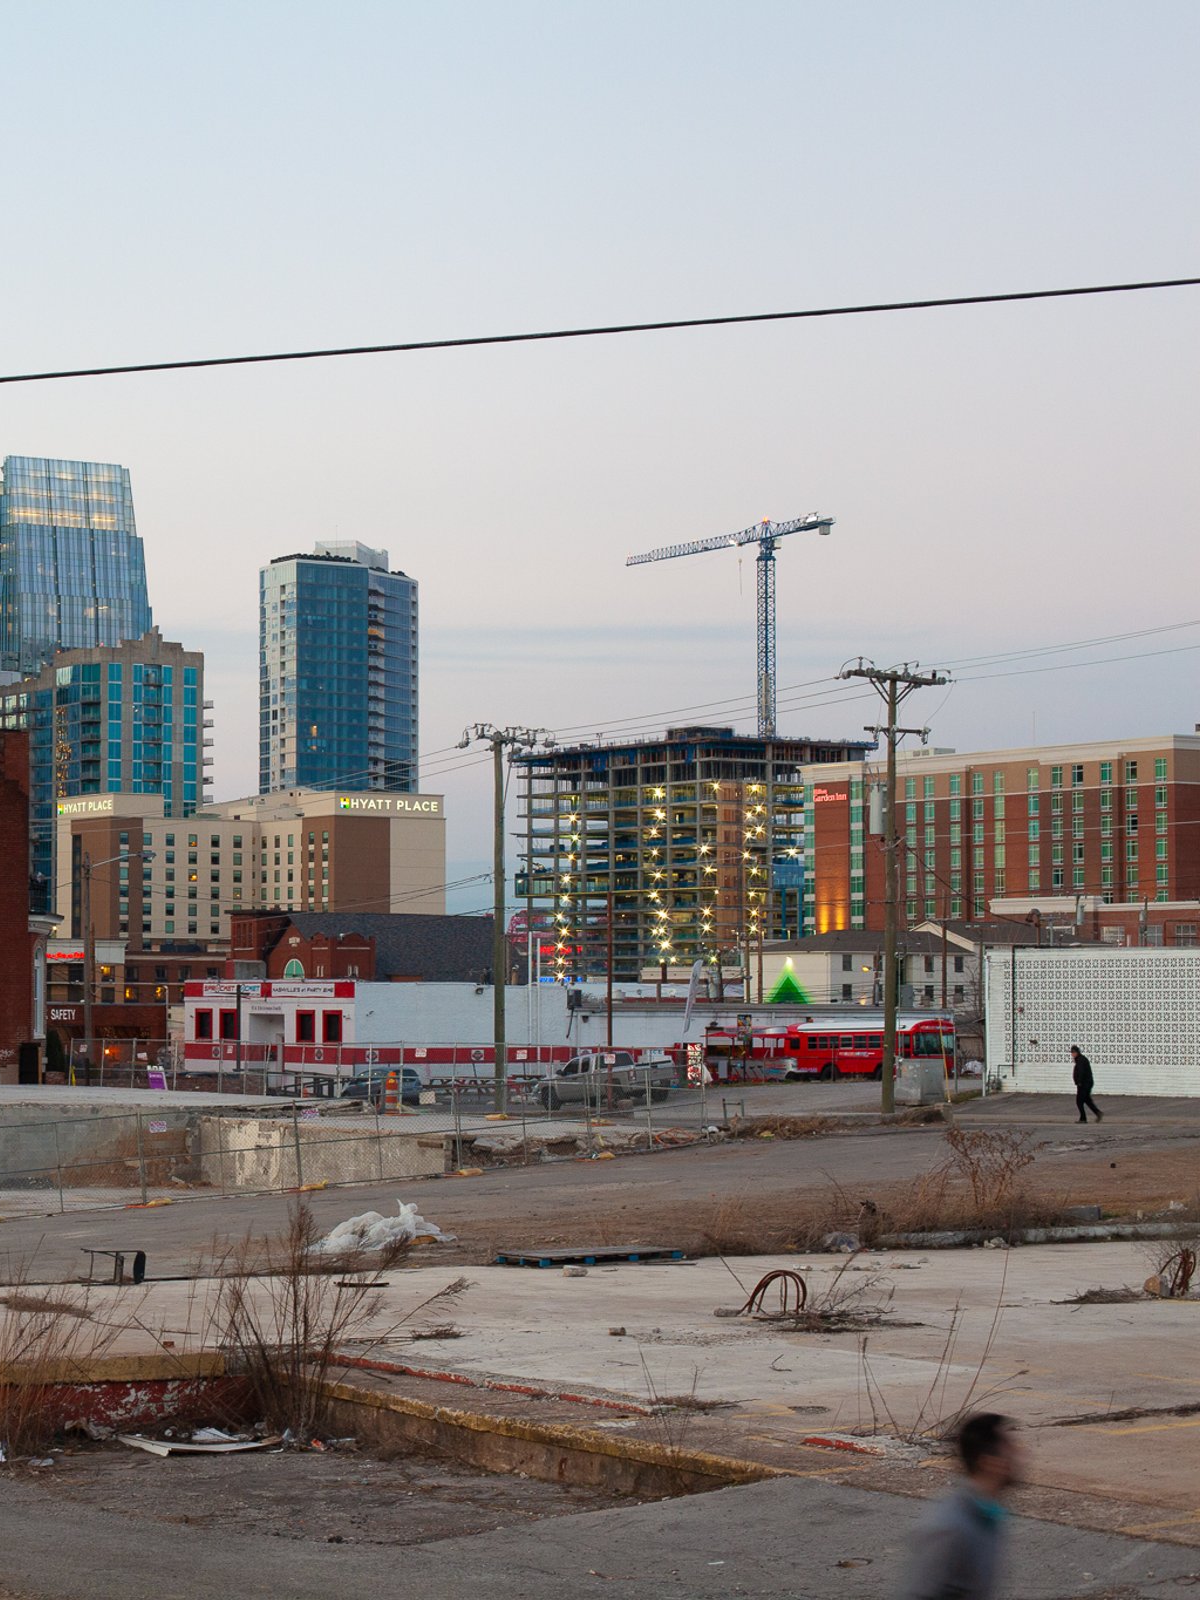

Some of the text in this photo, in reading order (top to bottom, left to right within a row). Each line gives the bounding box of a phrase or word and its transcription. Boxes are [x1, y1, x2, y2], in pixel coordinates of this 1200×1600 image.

[813, 793, 835, 802] Garden
[64, 801, 87, 814] HYATT
[88, 799, 113, 811] PLACE
[351, 798, 392, 810] HYATT
[396, 800, 439, 812] PLACE
[50, 1008, 76, 1020] SAFETY
